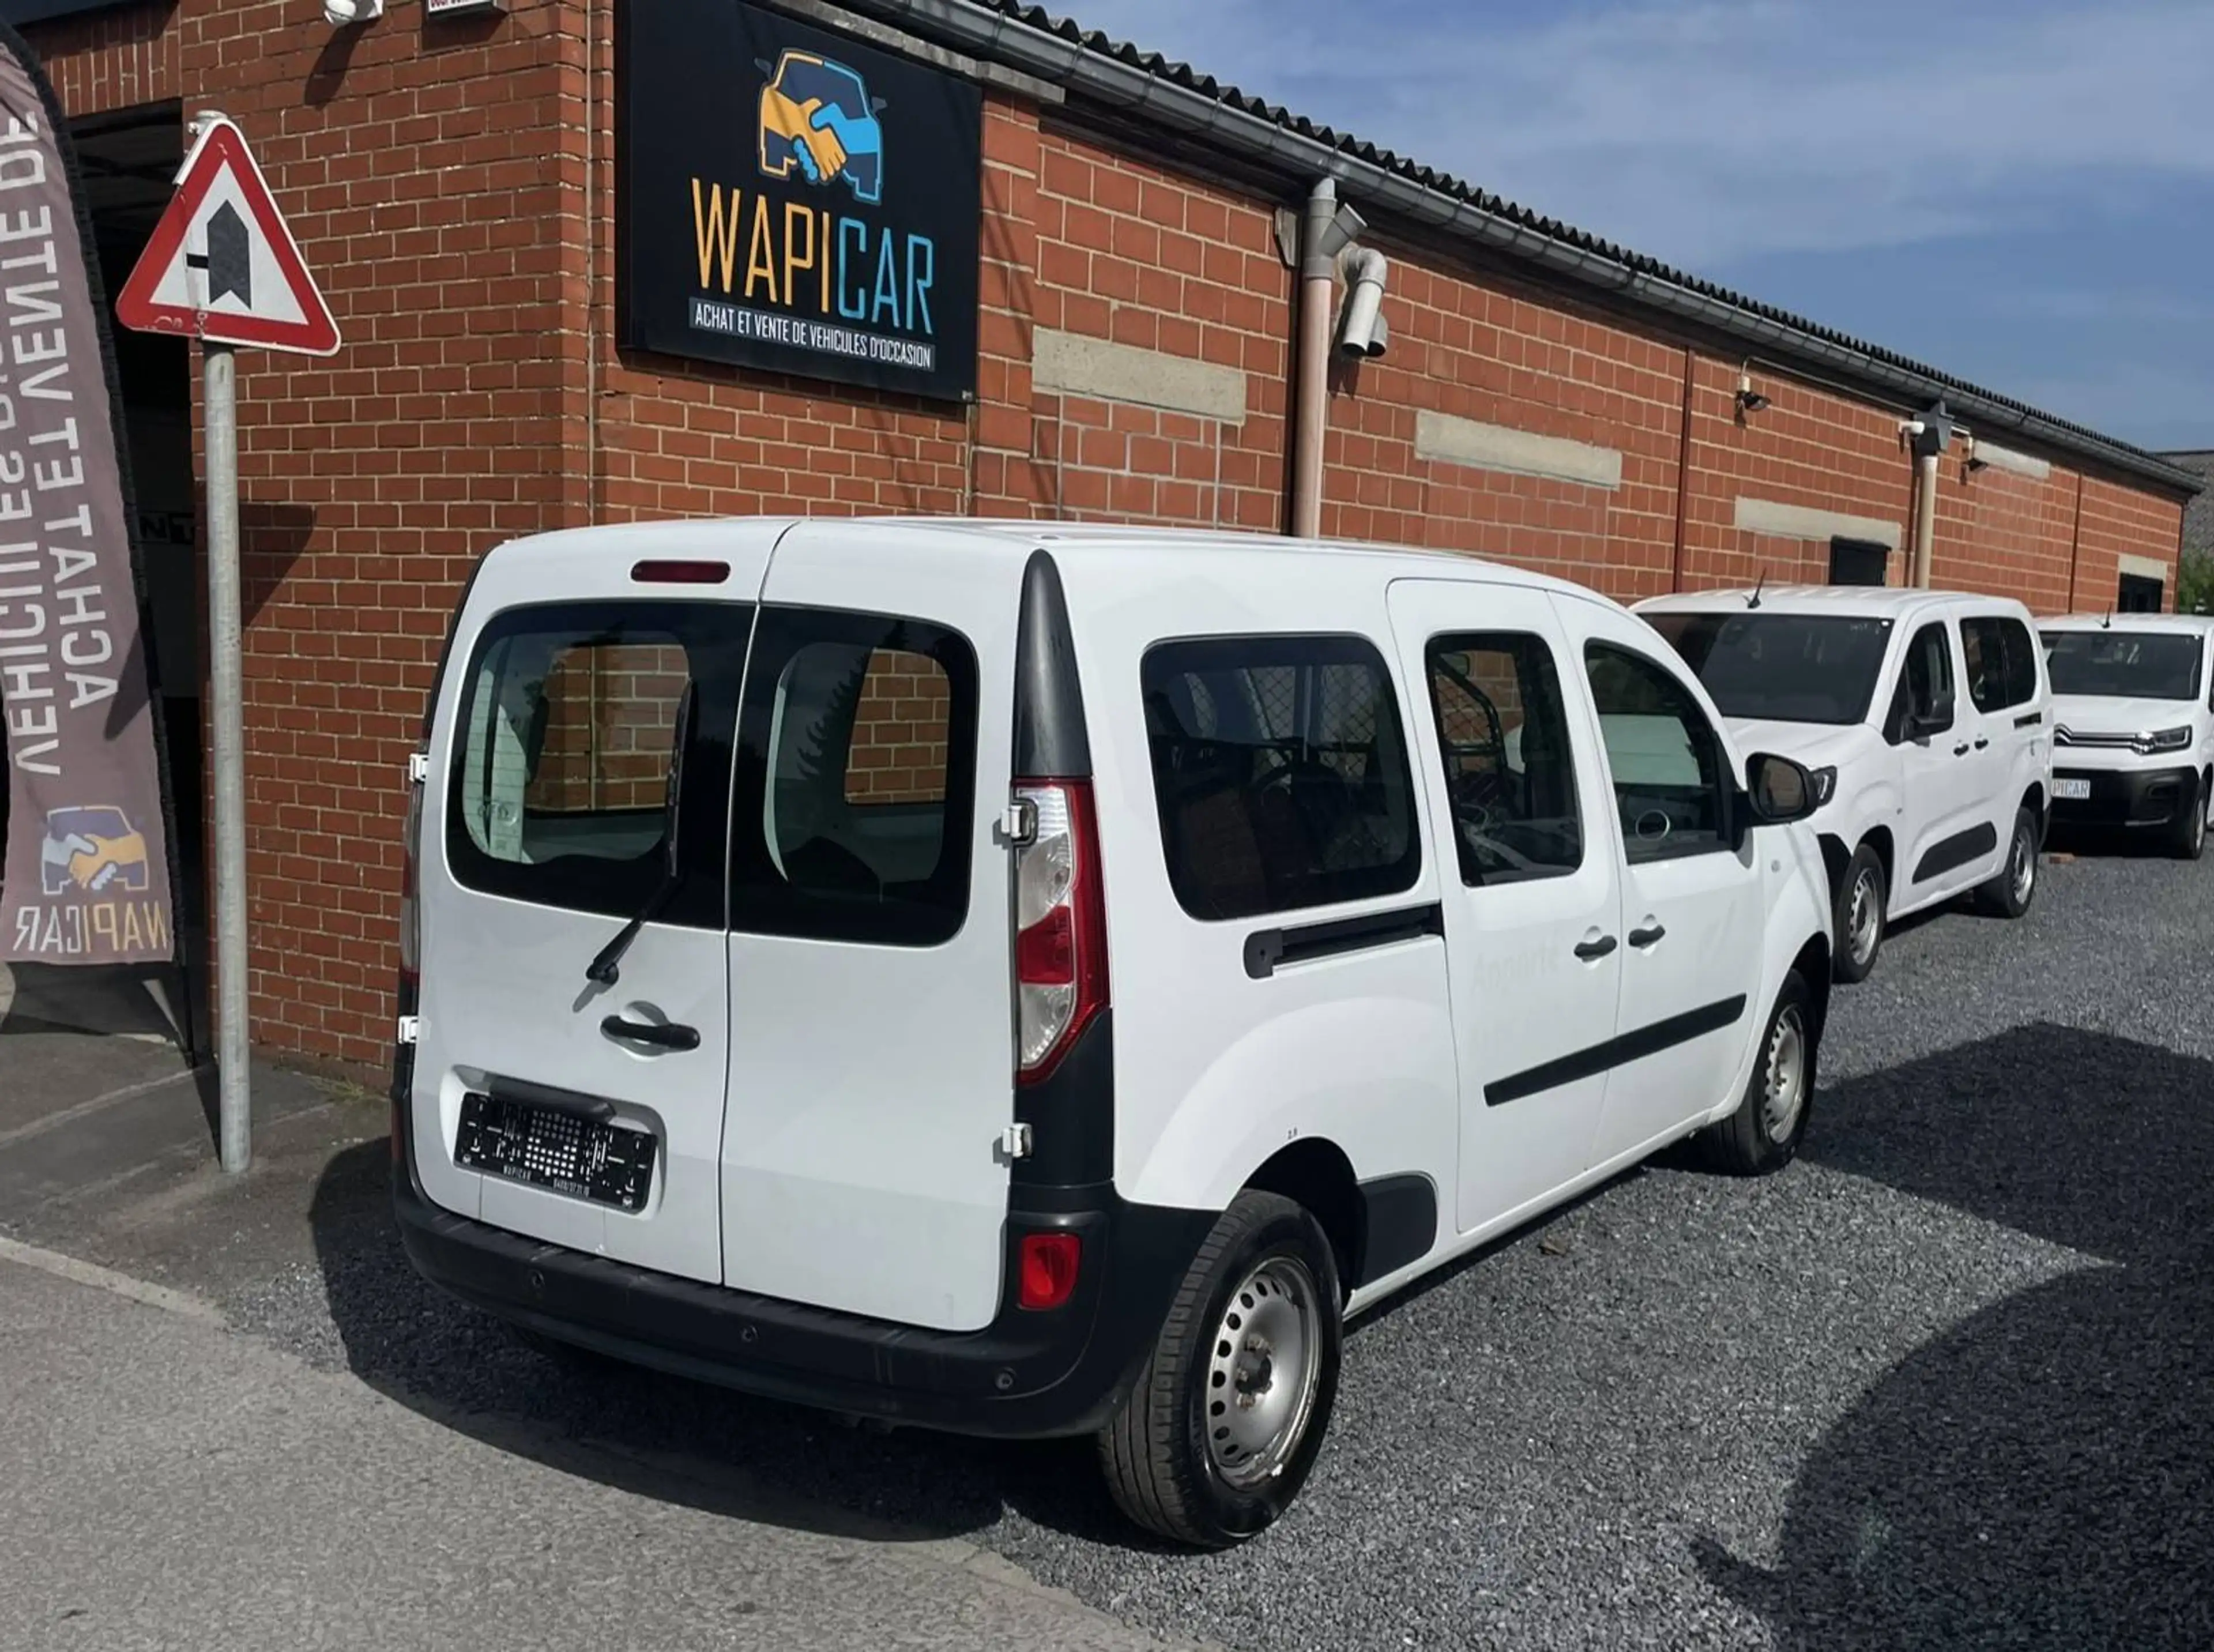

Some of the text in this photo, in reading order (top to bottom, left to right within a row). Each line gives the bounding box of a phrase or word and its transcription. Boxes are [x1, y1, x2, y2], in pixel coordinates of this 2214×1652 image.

[692, 177, 933, 334] WAPICAR
[695, 302, 931, 368] ACHAT ET VENTE DE VEHICULES D'OCCASION
